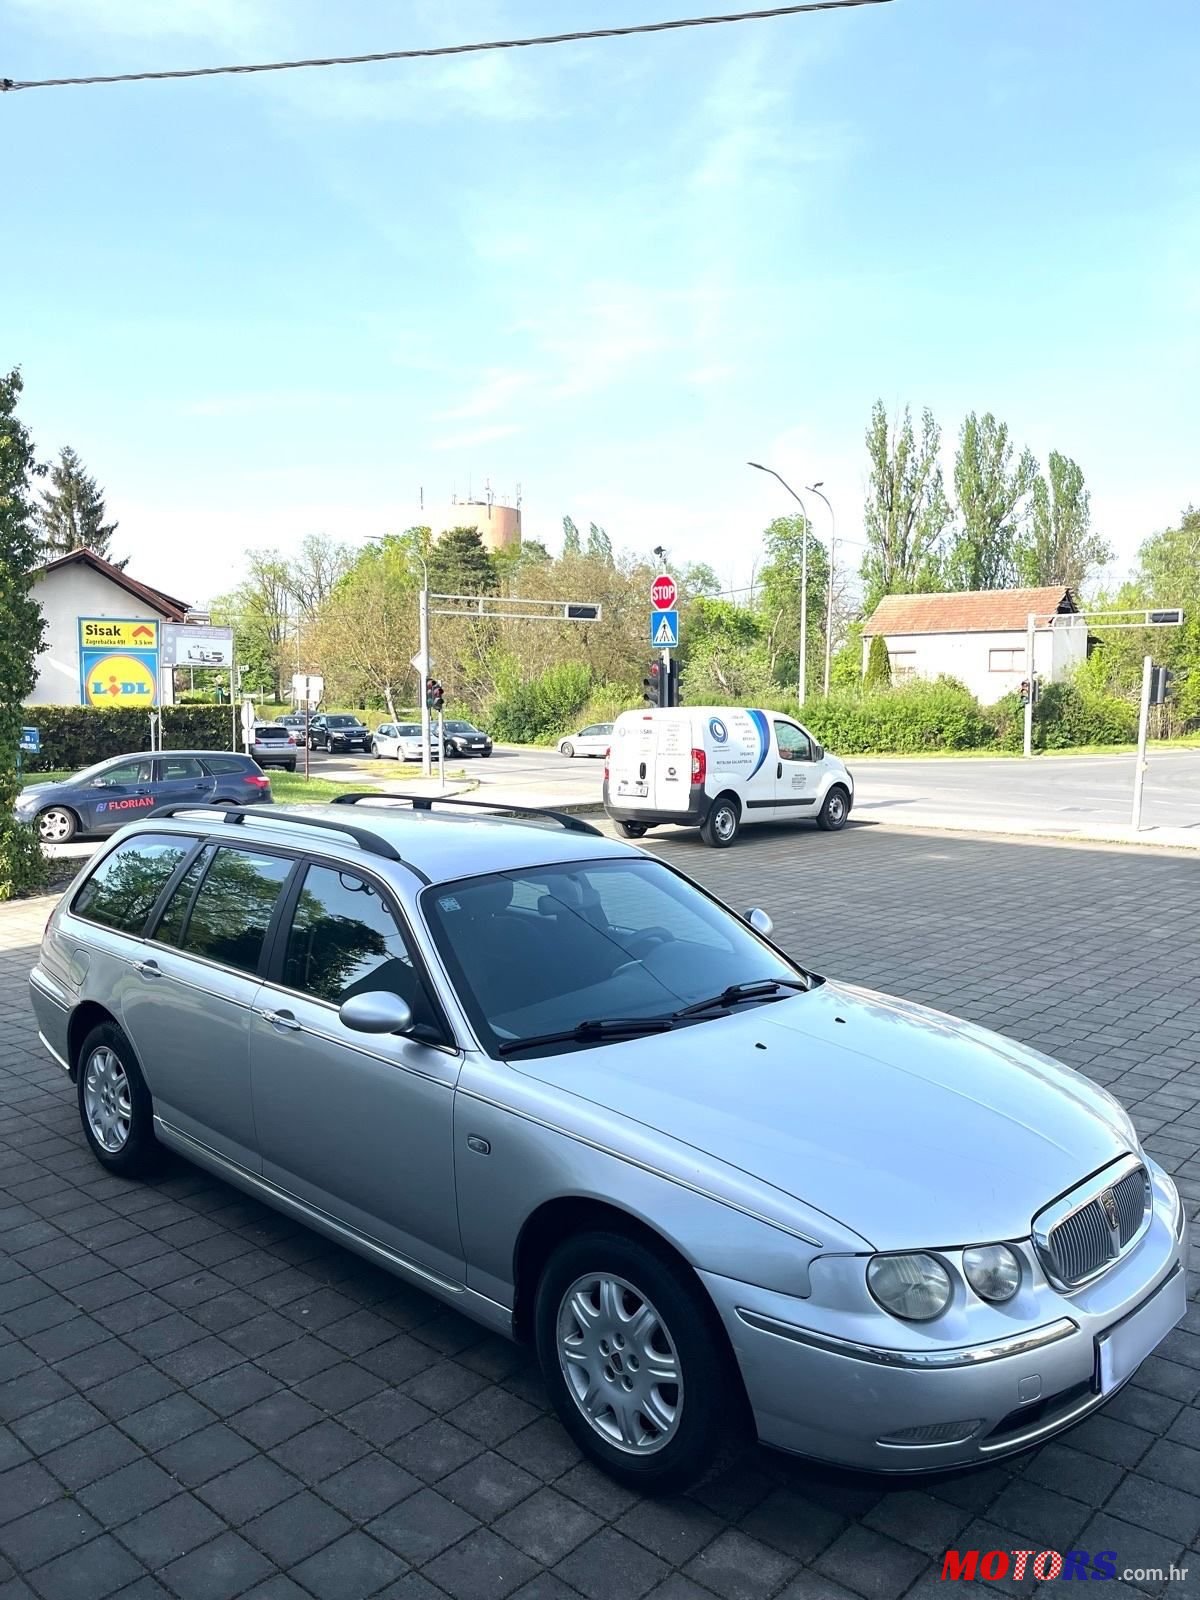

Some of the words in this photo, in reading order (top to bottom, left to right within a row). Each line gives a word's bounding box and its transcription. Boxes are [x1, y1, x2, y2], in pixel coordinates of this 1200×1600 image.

[652, 585, 676, 601] STOP
[85, 624, 121, 636] Sisak
[85, 638, 116, 646] Zagrebačka
[108, 796, 154, 811] FLORIAN
